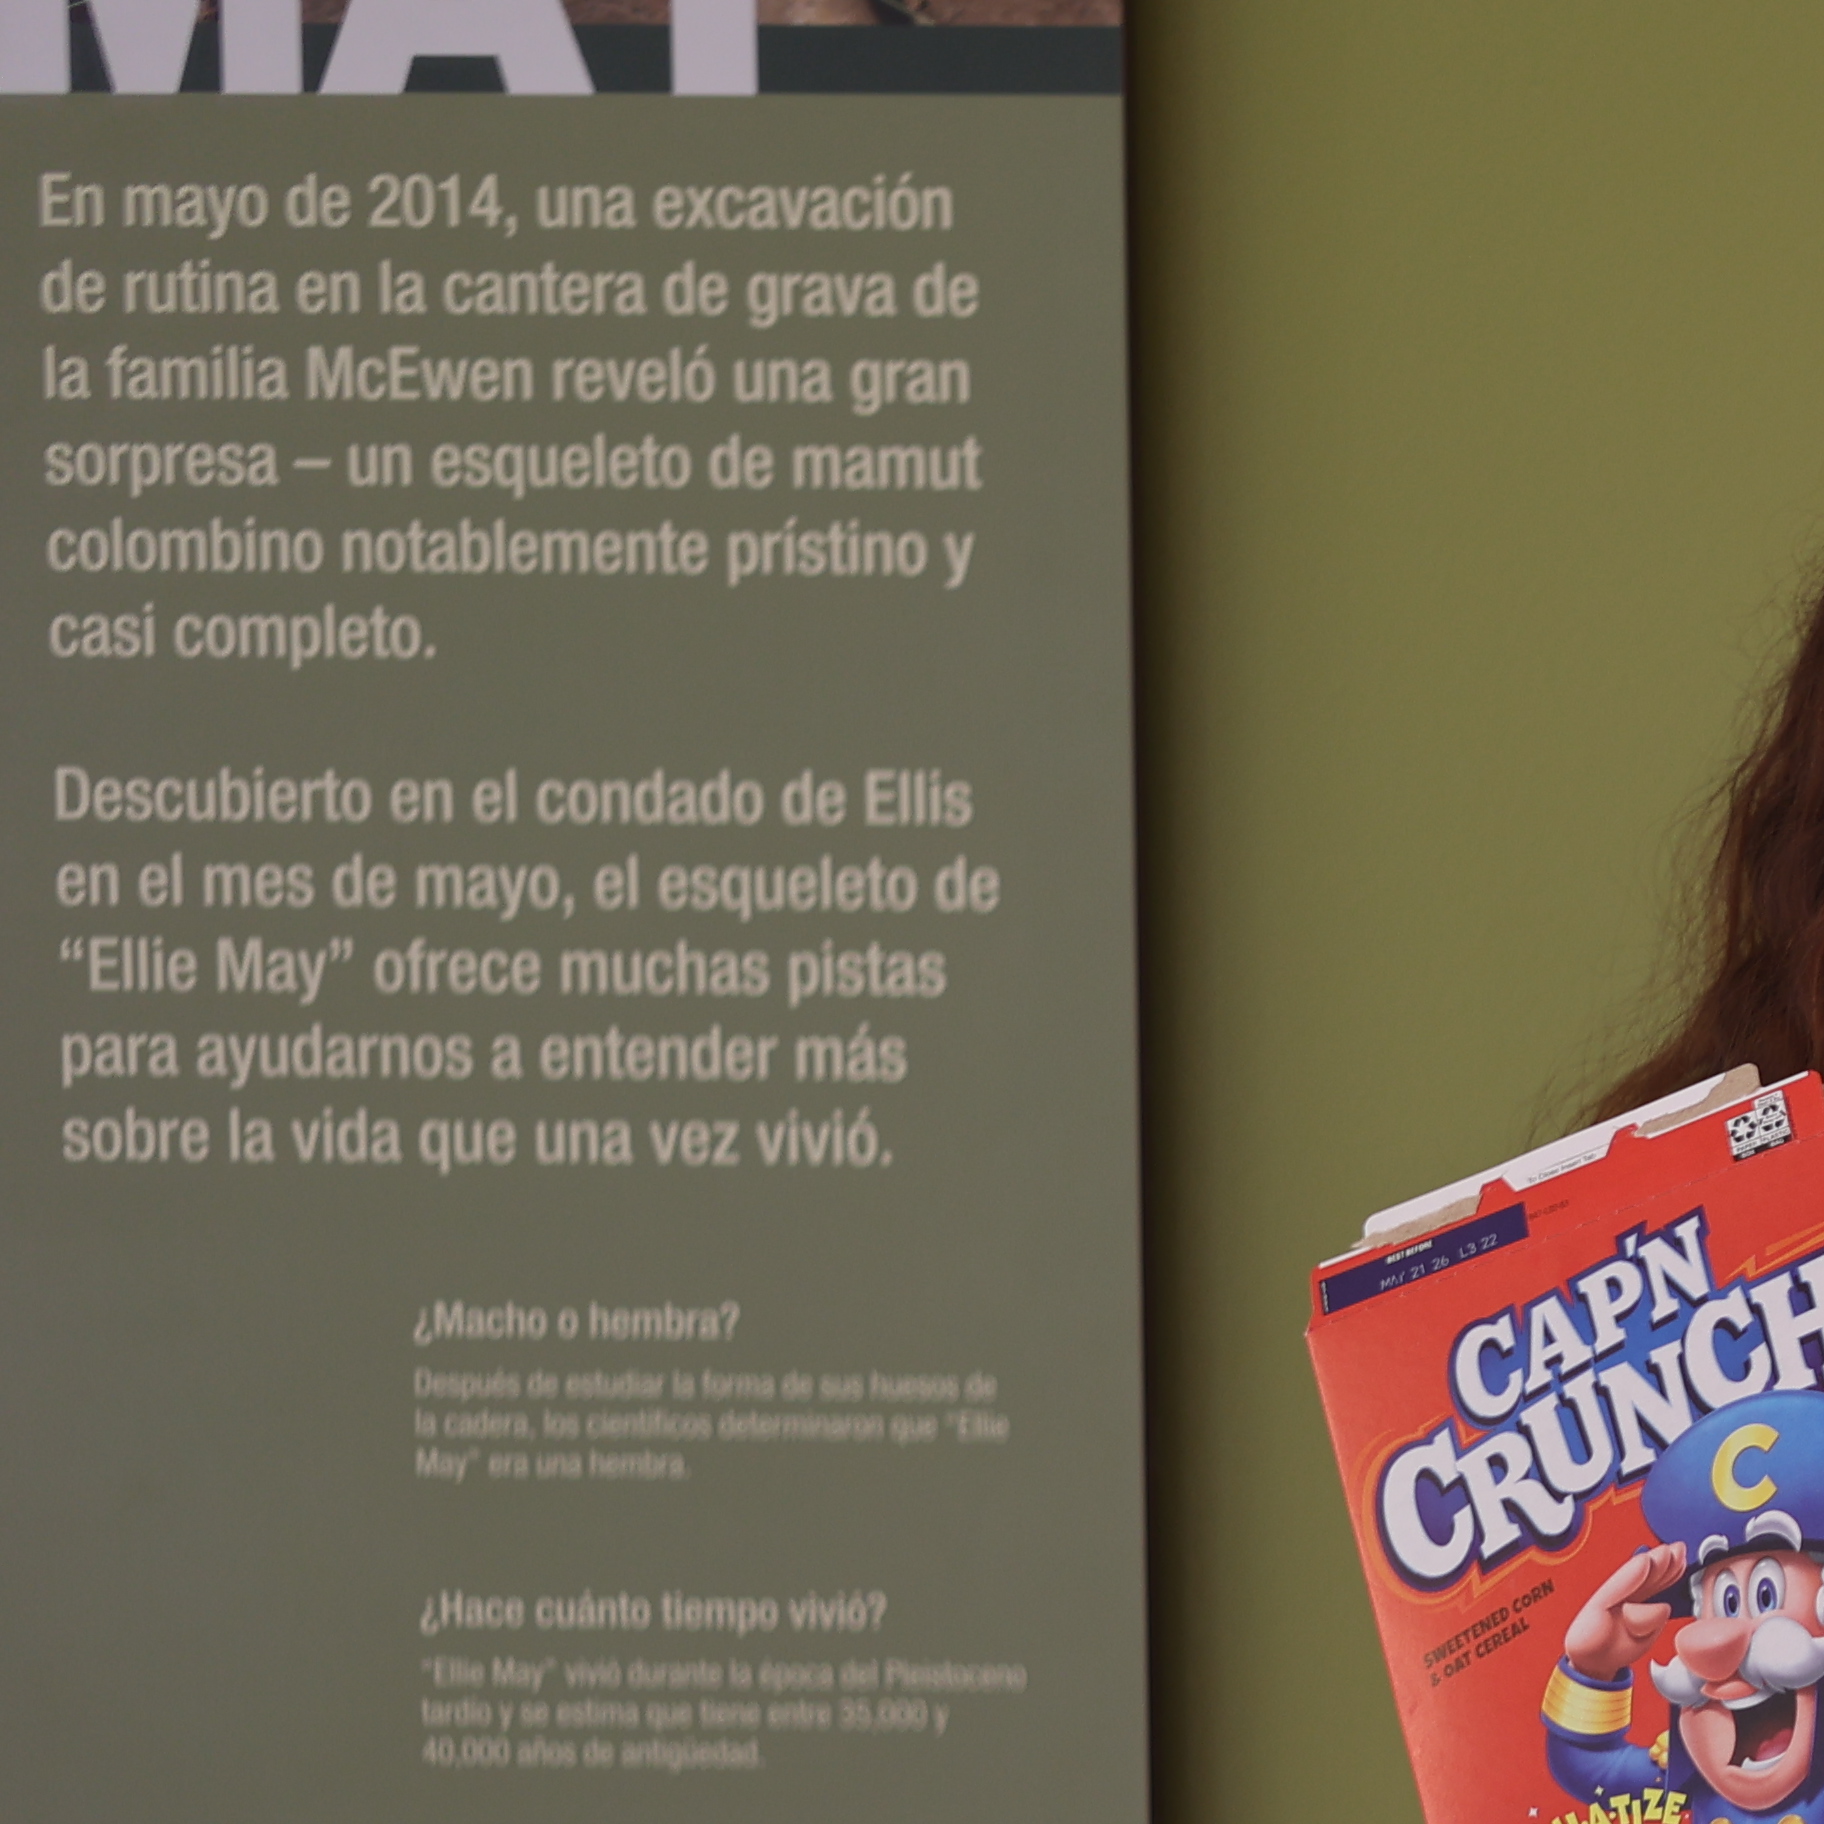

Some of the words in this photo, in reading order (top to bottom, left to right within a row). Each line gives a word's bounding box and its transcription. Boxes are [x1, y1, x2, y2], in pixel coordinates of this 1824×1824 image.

[40, 172, 104, 226] En
[124, 184, 268, 240] mayo
[285, 173, 350, 228] de
[369, 173, 517, 237] 2014,
[537, 185, 637, 229] una
[653, 172, 953, 231] excavación
[44, 345, 91, 400] la
[106, 344, 289, 400] familia
[307, 345, 533, 401] McEwen
[552, 344, 716, 403] reveló
[734, 359, 833, 403] una
[850, 359, 970, 416] gran
[55, 766, 372, 823] Descubierto
[390, 779, 453, 823] en
[472, 768, 517, 823] el
[536, 768, 764, 825] condado
[781, 769, 846, 826] de
[865, 769, 973, 827] Ellis
[1380, 1270, 1406, 1291] MAY
[1410, 1262, 1426, 1280] 21
[1431, 1255, 1450, 1272] 26
[1480, 1233, 1498, 1251] 22
[413, 1300, 547, 1346] ¿Macho
[557, 1308, 579, 1339] o
[589, 1301, 740, 1340] hembra?
[1453, 1214, 1713, 1420] CAP'N
[1710, 1422, 1781, 1512] C
[1423, 1606, 1511, 1669] SWEETENED
[1511, 1578, 1556, 1614] CORN
[1429, 1672, 1442, 1687] &
[1443, 1652, 1473, 1679] OAT
[1475, 1616, 1531, 1659] CEREAL
